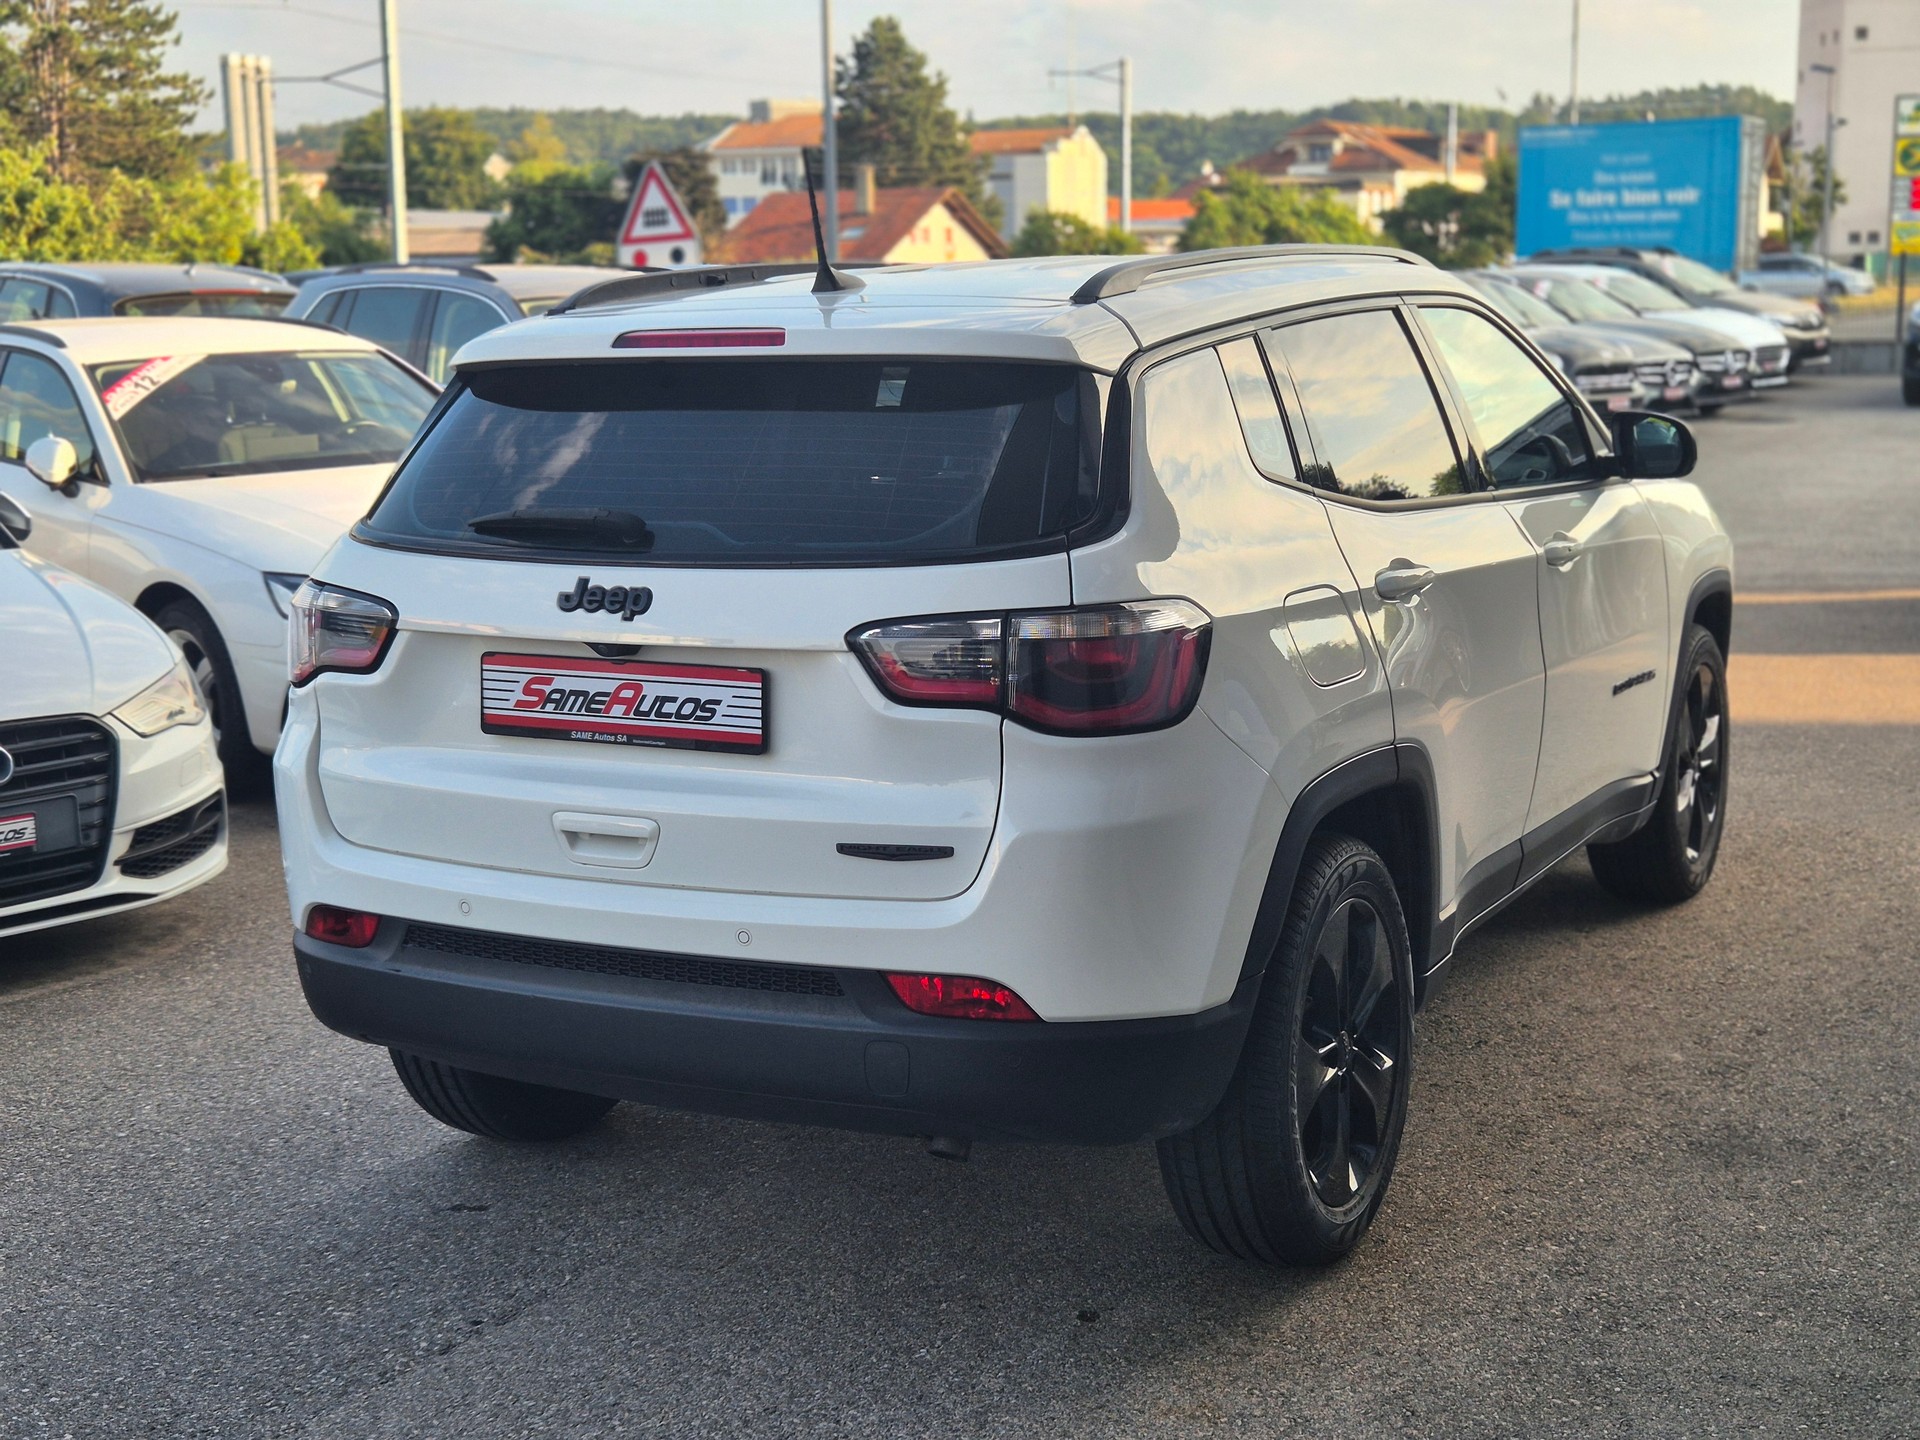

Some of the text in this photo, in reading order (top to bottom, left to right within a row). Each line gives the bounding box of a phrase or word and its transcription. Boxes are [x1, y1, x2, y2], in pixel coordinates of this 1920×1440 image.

[556, 576, 653, 621] Jeep
[570, 730, 593, 740] SAME
[594, 732, 615, 741] Autos
[616, 734, 627, 743] SA
